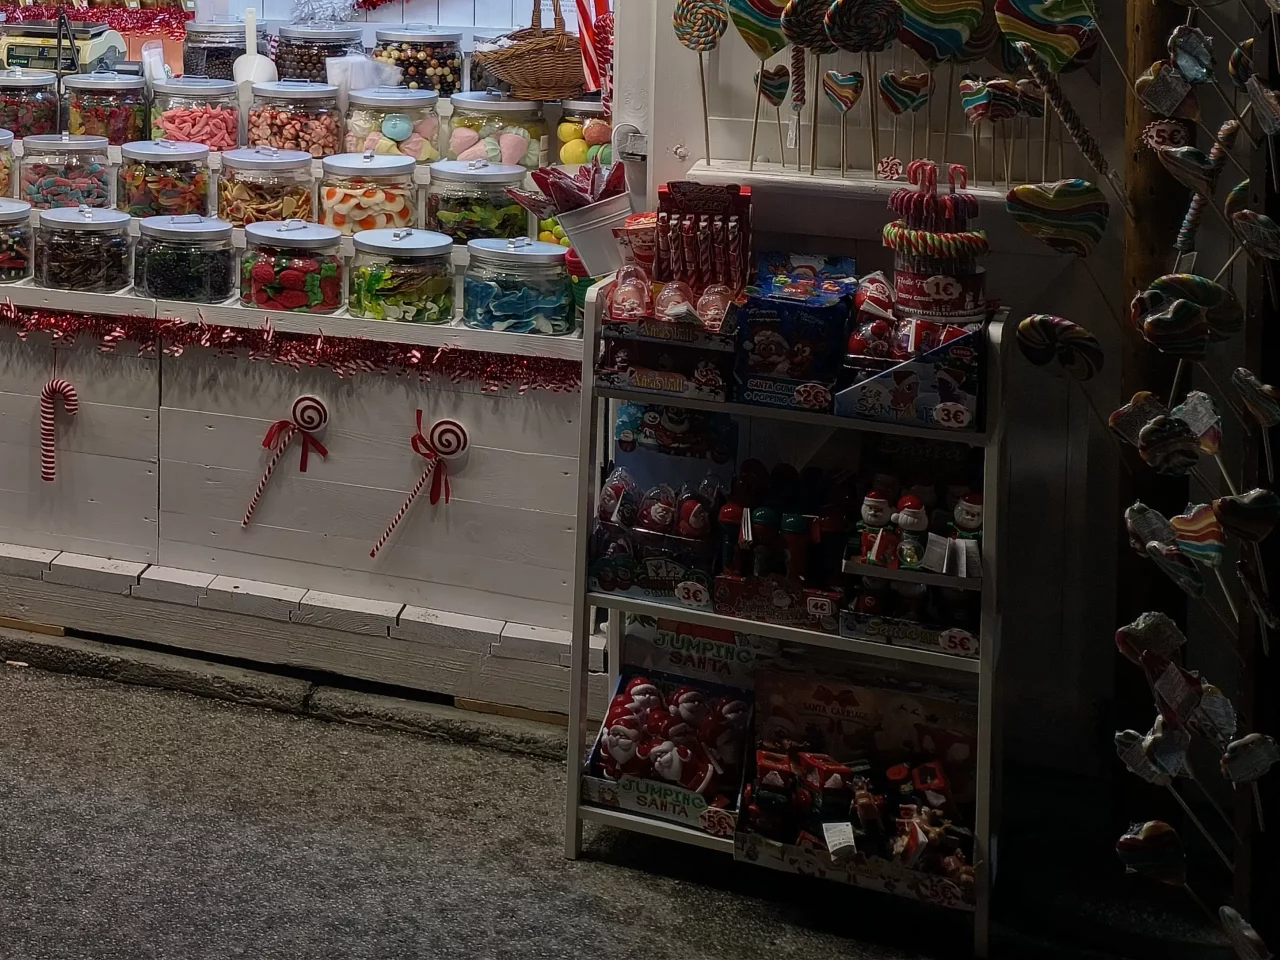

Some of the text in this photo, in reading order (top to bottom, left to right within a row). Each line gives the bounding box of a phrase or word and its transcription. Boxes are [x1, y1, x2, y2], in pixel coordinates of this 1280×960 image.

[1155, 128, 1181, 145] 5€
[881, 160, 898, 175] 2€
[934, 281, 954, 296] 1€
[748, 379, 774, 392] SANTA
[753, 392, 788, 405] POPPING
[801, 388, 825, 404] 2€
[855, 398, 915, 420] SANTA
[941, 408, 965, 424] 3€
[682, 587, 703, 603] 3€
[812, 602, 827, 612] 4€
[654, 632, 754, 663] JUMPING
[947, 635, 970, 651] 5€
[669, 651, 732, 677] SANTA
[802, 701, 827, 714] SANTA
[622, 779, 707, 810] JUMPING
[636, 794, 689, 818] SANTA
[707, 814, 728, 830] 5€
